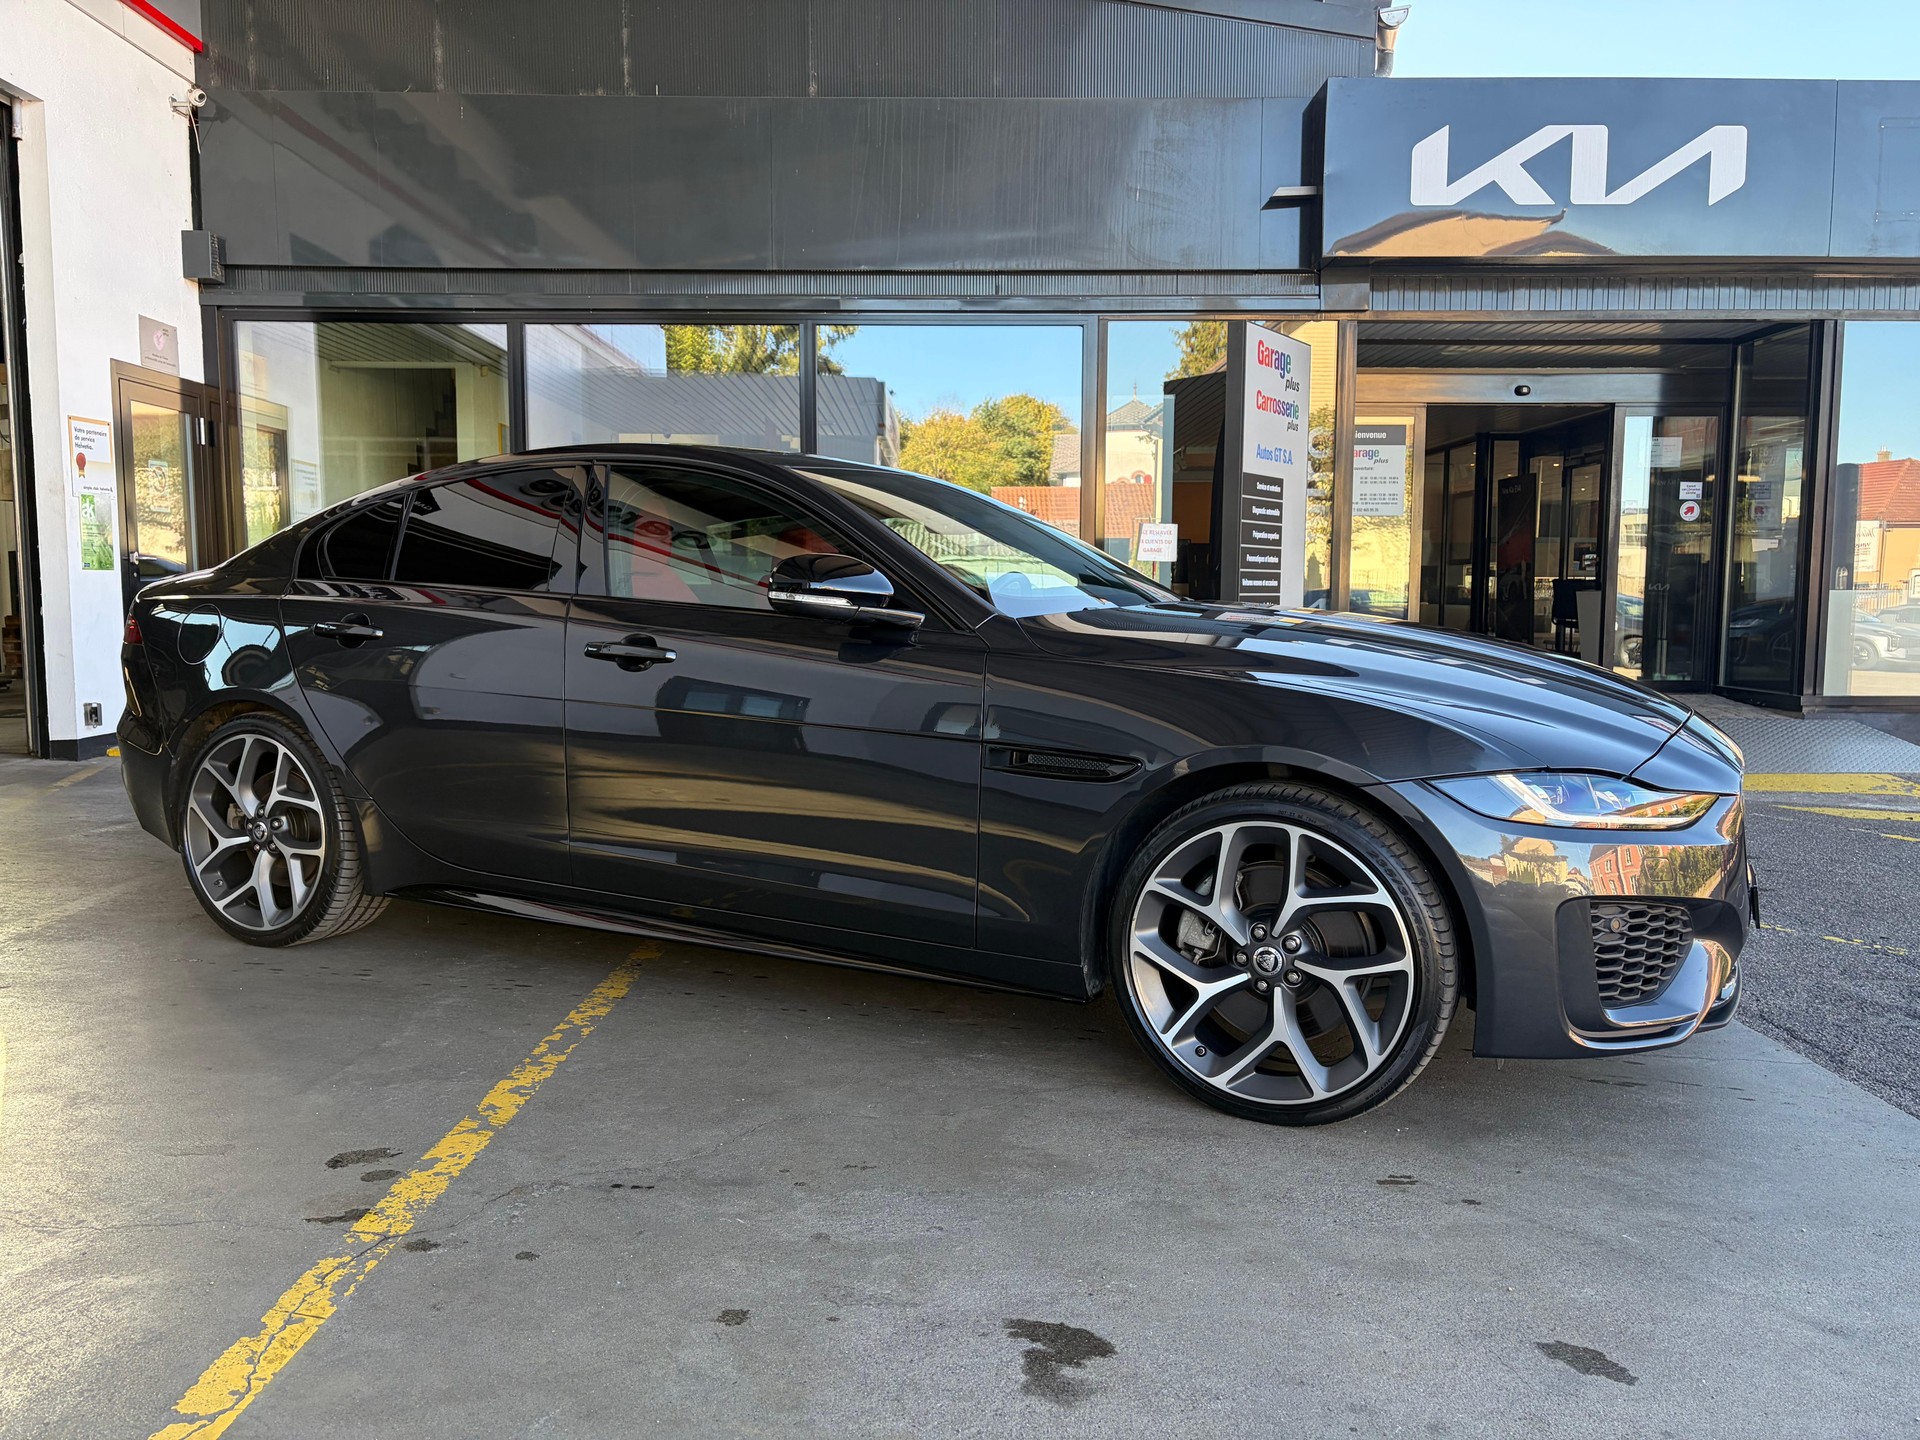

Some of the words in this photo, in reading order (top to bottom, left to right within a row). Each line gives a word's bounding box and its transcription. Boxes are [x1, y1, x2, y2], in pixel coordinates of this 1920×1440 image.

[1410, 125, 1747, 206] KIA
[1257, 339, 1291, 379] Garage
[1285, 377, 1300, 392] plus
[1256, 389, 1299, 420] Carrosserie
[1286, 420, 1299, 432] plus
[1354, 430, 1387, 439] ienvenue
[1256, 443, 1273, 462] Autos
[1274, 447, 1282, 463] GT
[1353, 449, 1380, 460] arage
[1373, 457, 1389, 465] plus
[1648, 582, 1671, 591] KIA
